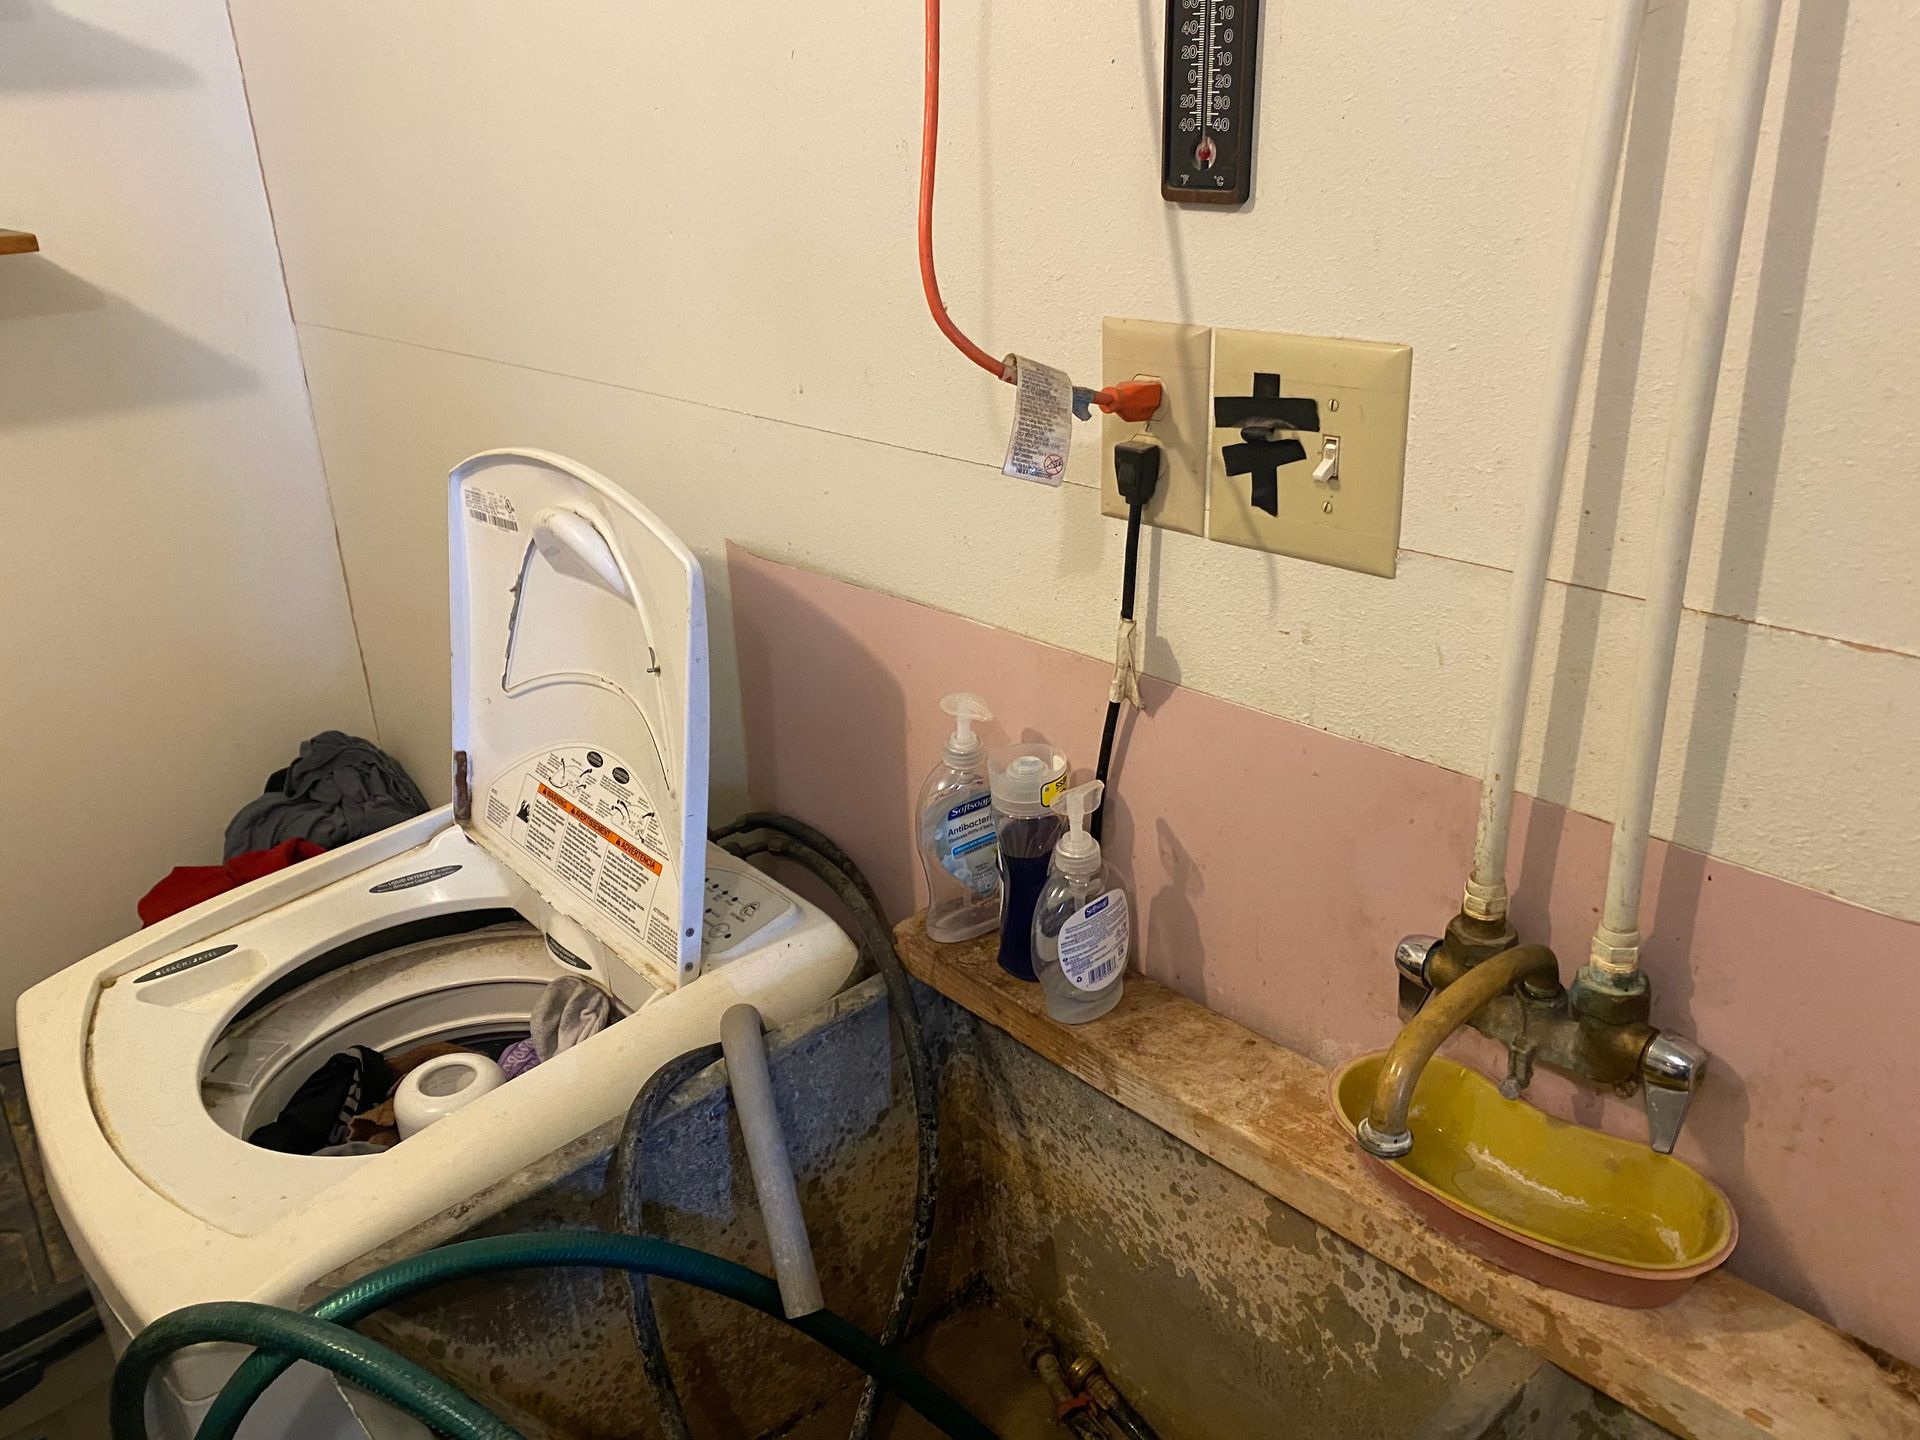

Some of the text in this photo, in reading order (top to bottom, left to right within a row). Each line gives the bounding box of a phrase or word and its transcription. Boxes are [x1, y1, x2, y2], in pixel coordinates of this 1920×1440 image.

[1218, 5, 1235, 20] 10
[1181, 20, 1199, 35] 40
[1223, 28, 1234, 44] 0
[1181, 44, 1198, 60] 20
[1216, 51, 1233, 66] 10
[1187, 70, 1197, 84] 0
[1214, 74, 1232, 88] 20
[1180, 94, 1196, 108] 20
[1213, 96, 1231, 110] 30
[1178, 118, 1196, 132] 40
[1212, 118, 1230, 132] 40
[951, 796, 991, 817] Softsoap
[546, 789, 568, 808] WARNING
[575, 806, 611, 838] AVERTISSEMENT
[621, 841, 656, 870] ADVERTENCIA
[948, 814, 993, 838] Antibacteri
